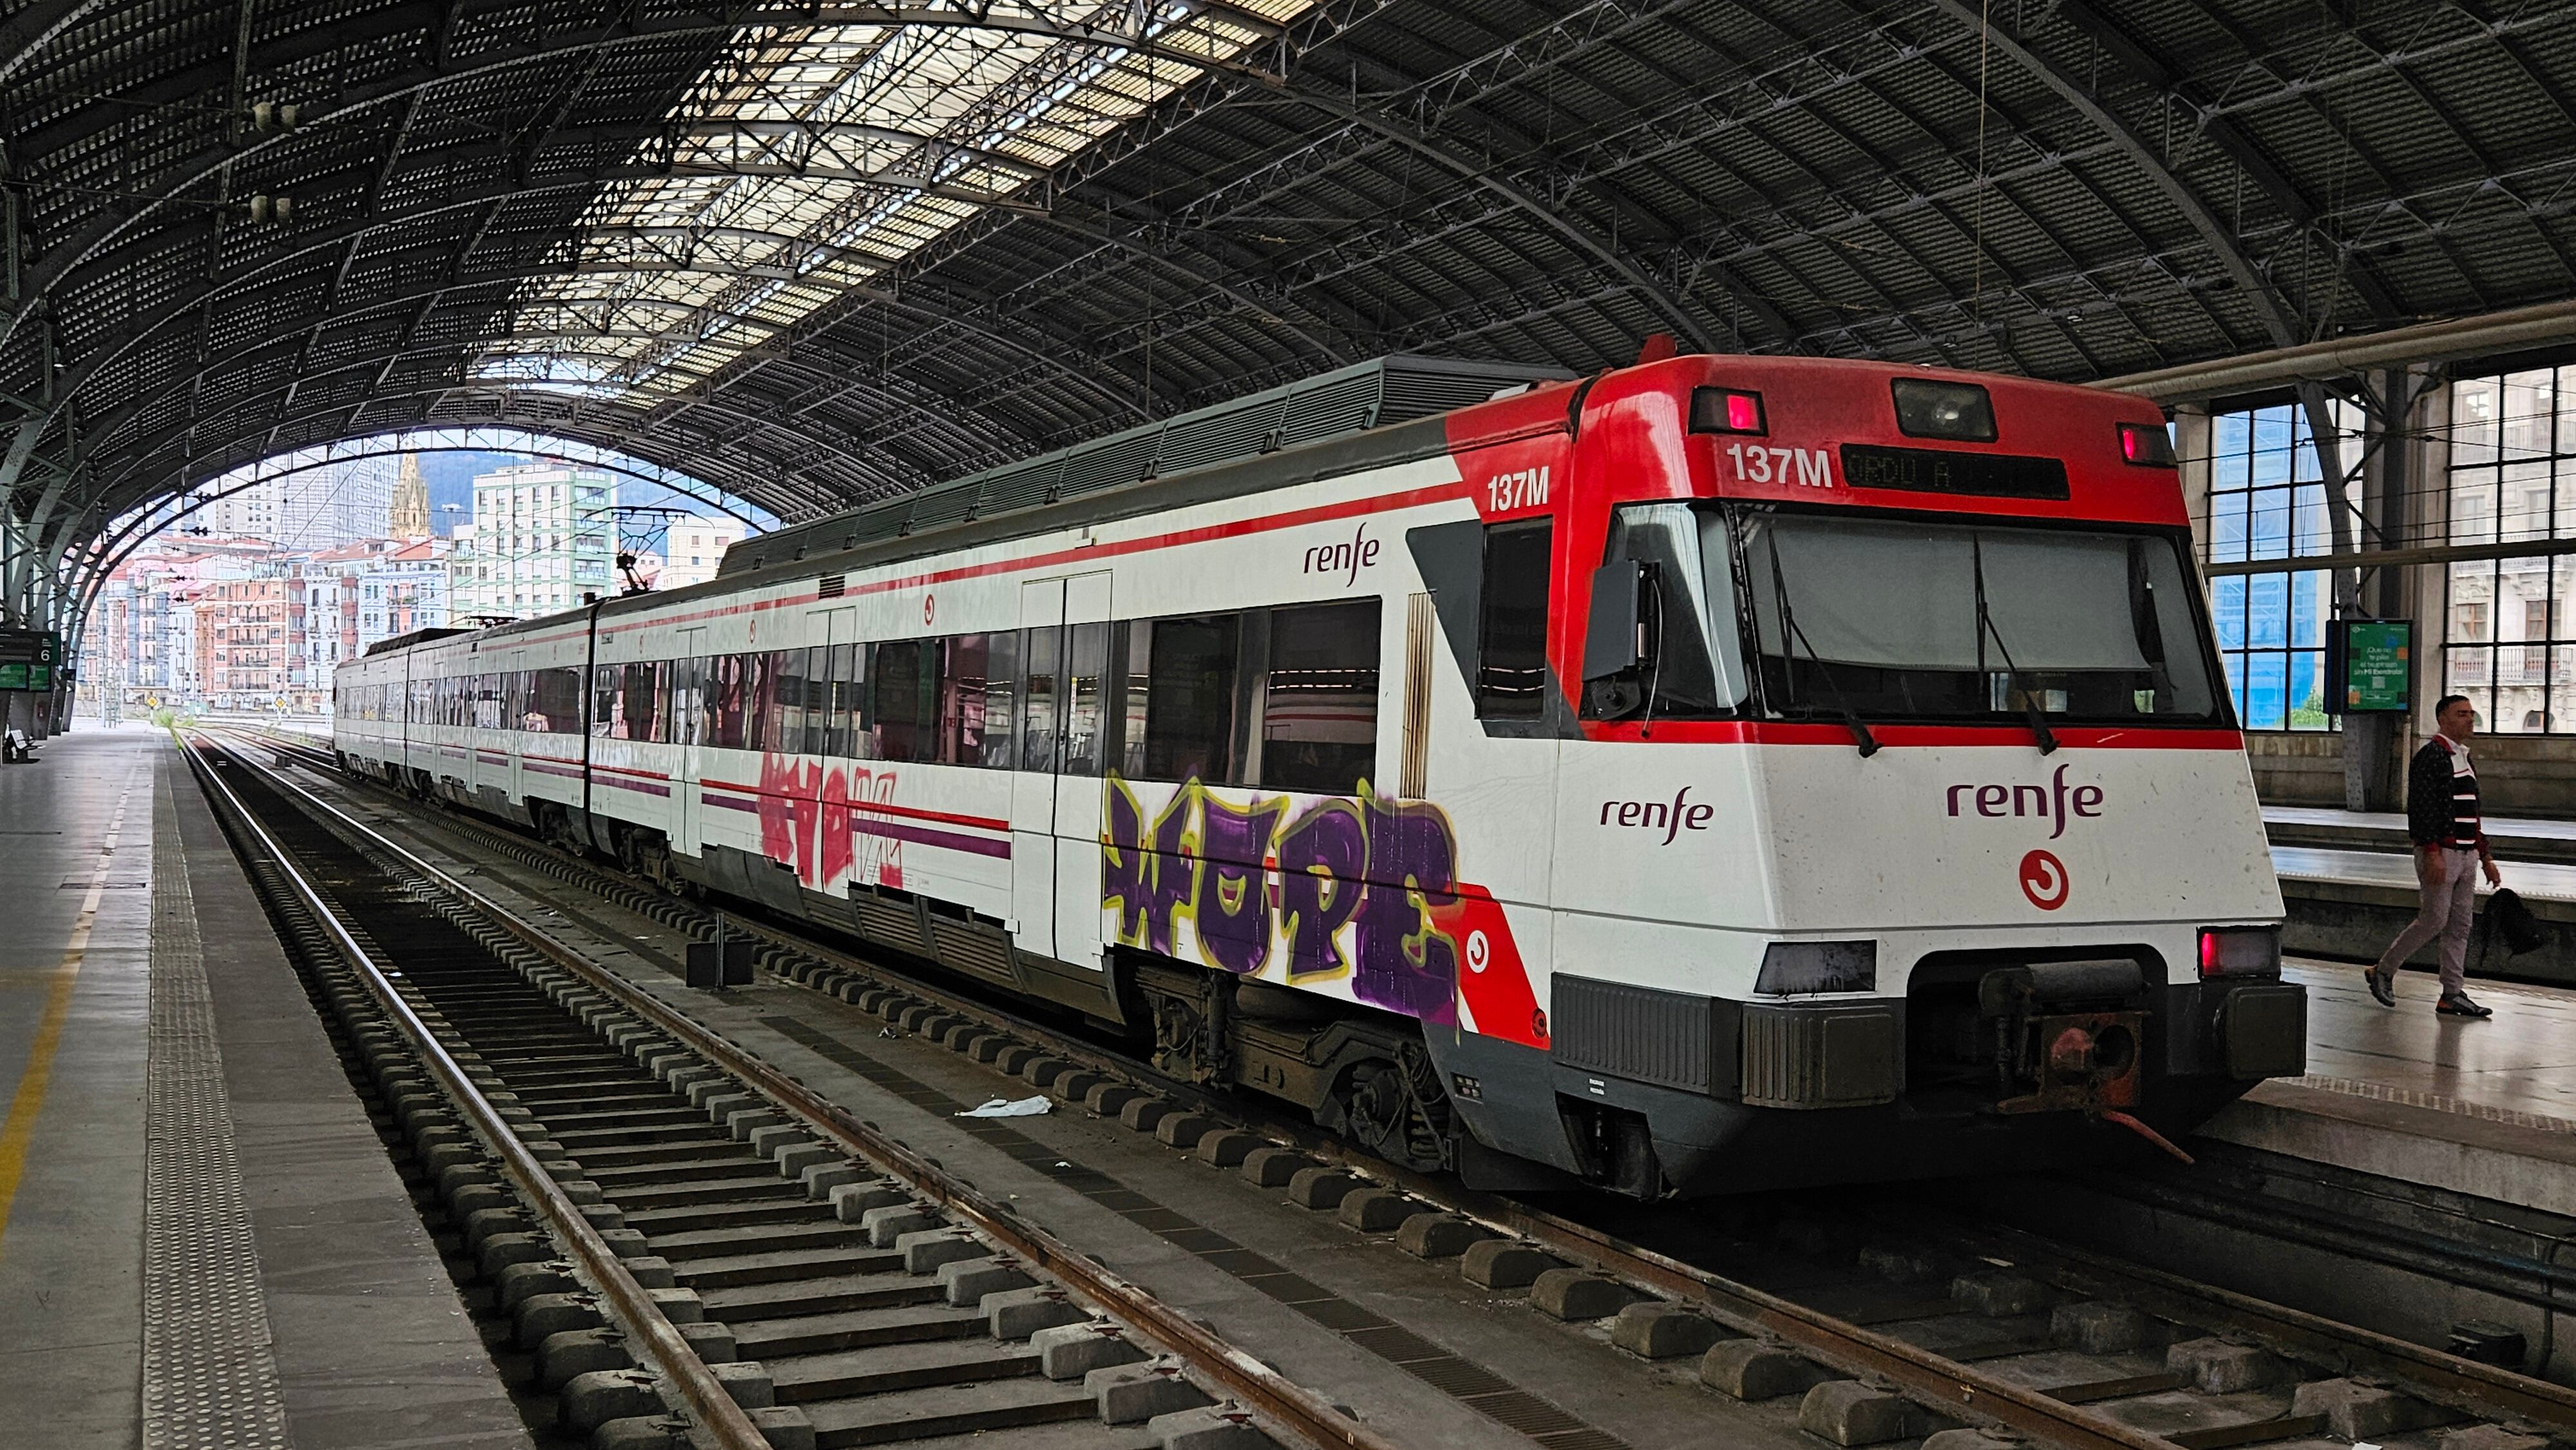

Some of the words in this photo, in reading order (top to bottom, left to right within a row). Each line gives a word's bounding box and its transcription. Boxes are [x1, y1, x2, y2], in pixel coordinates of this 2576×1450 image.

[1488, 466, 1549, 512] 137M
[1727, 443, 1832, 488] 137M
[1303, 522, 1379, 588] renfe
[41, 649, 50, 662] 6
[1600, 786, 1714, 847] renfe
[1946, 763, 2104, 840] renfe
